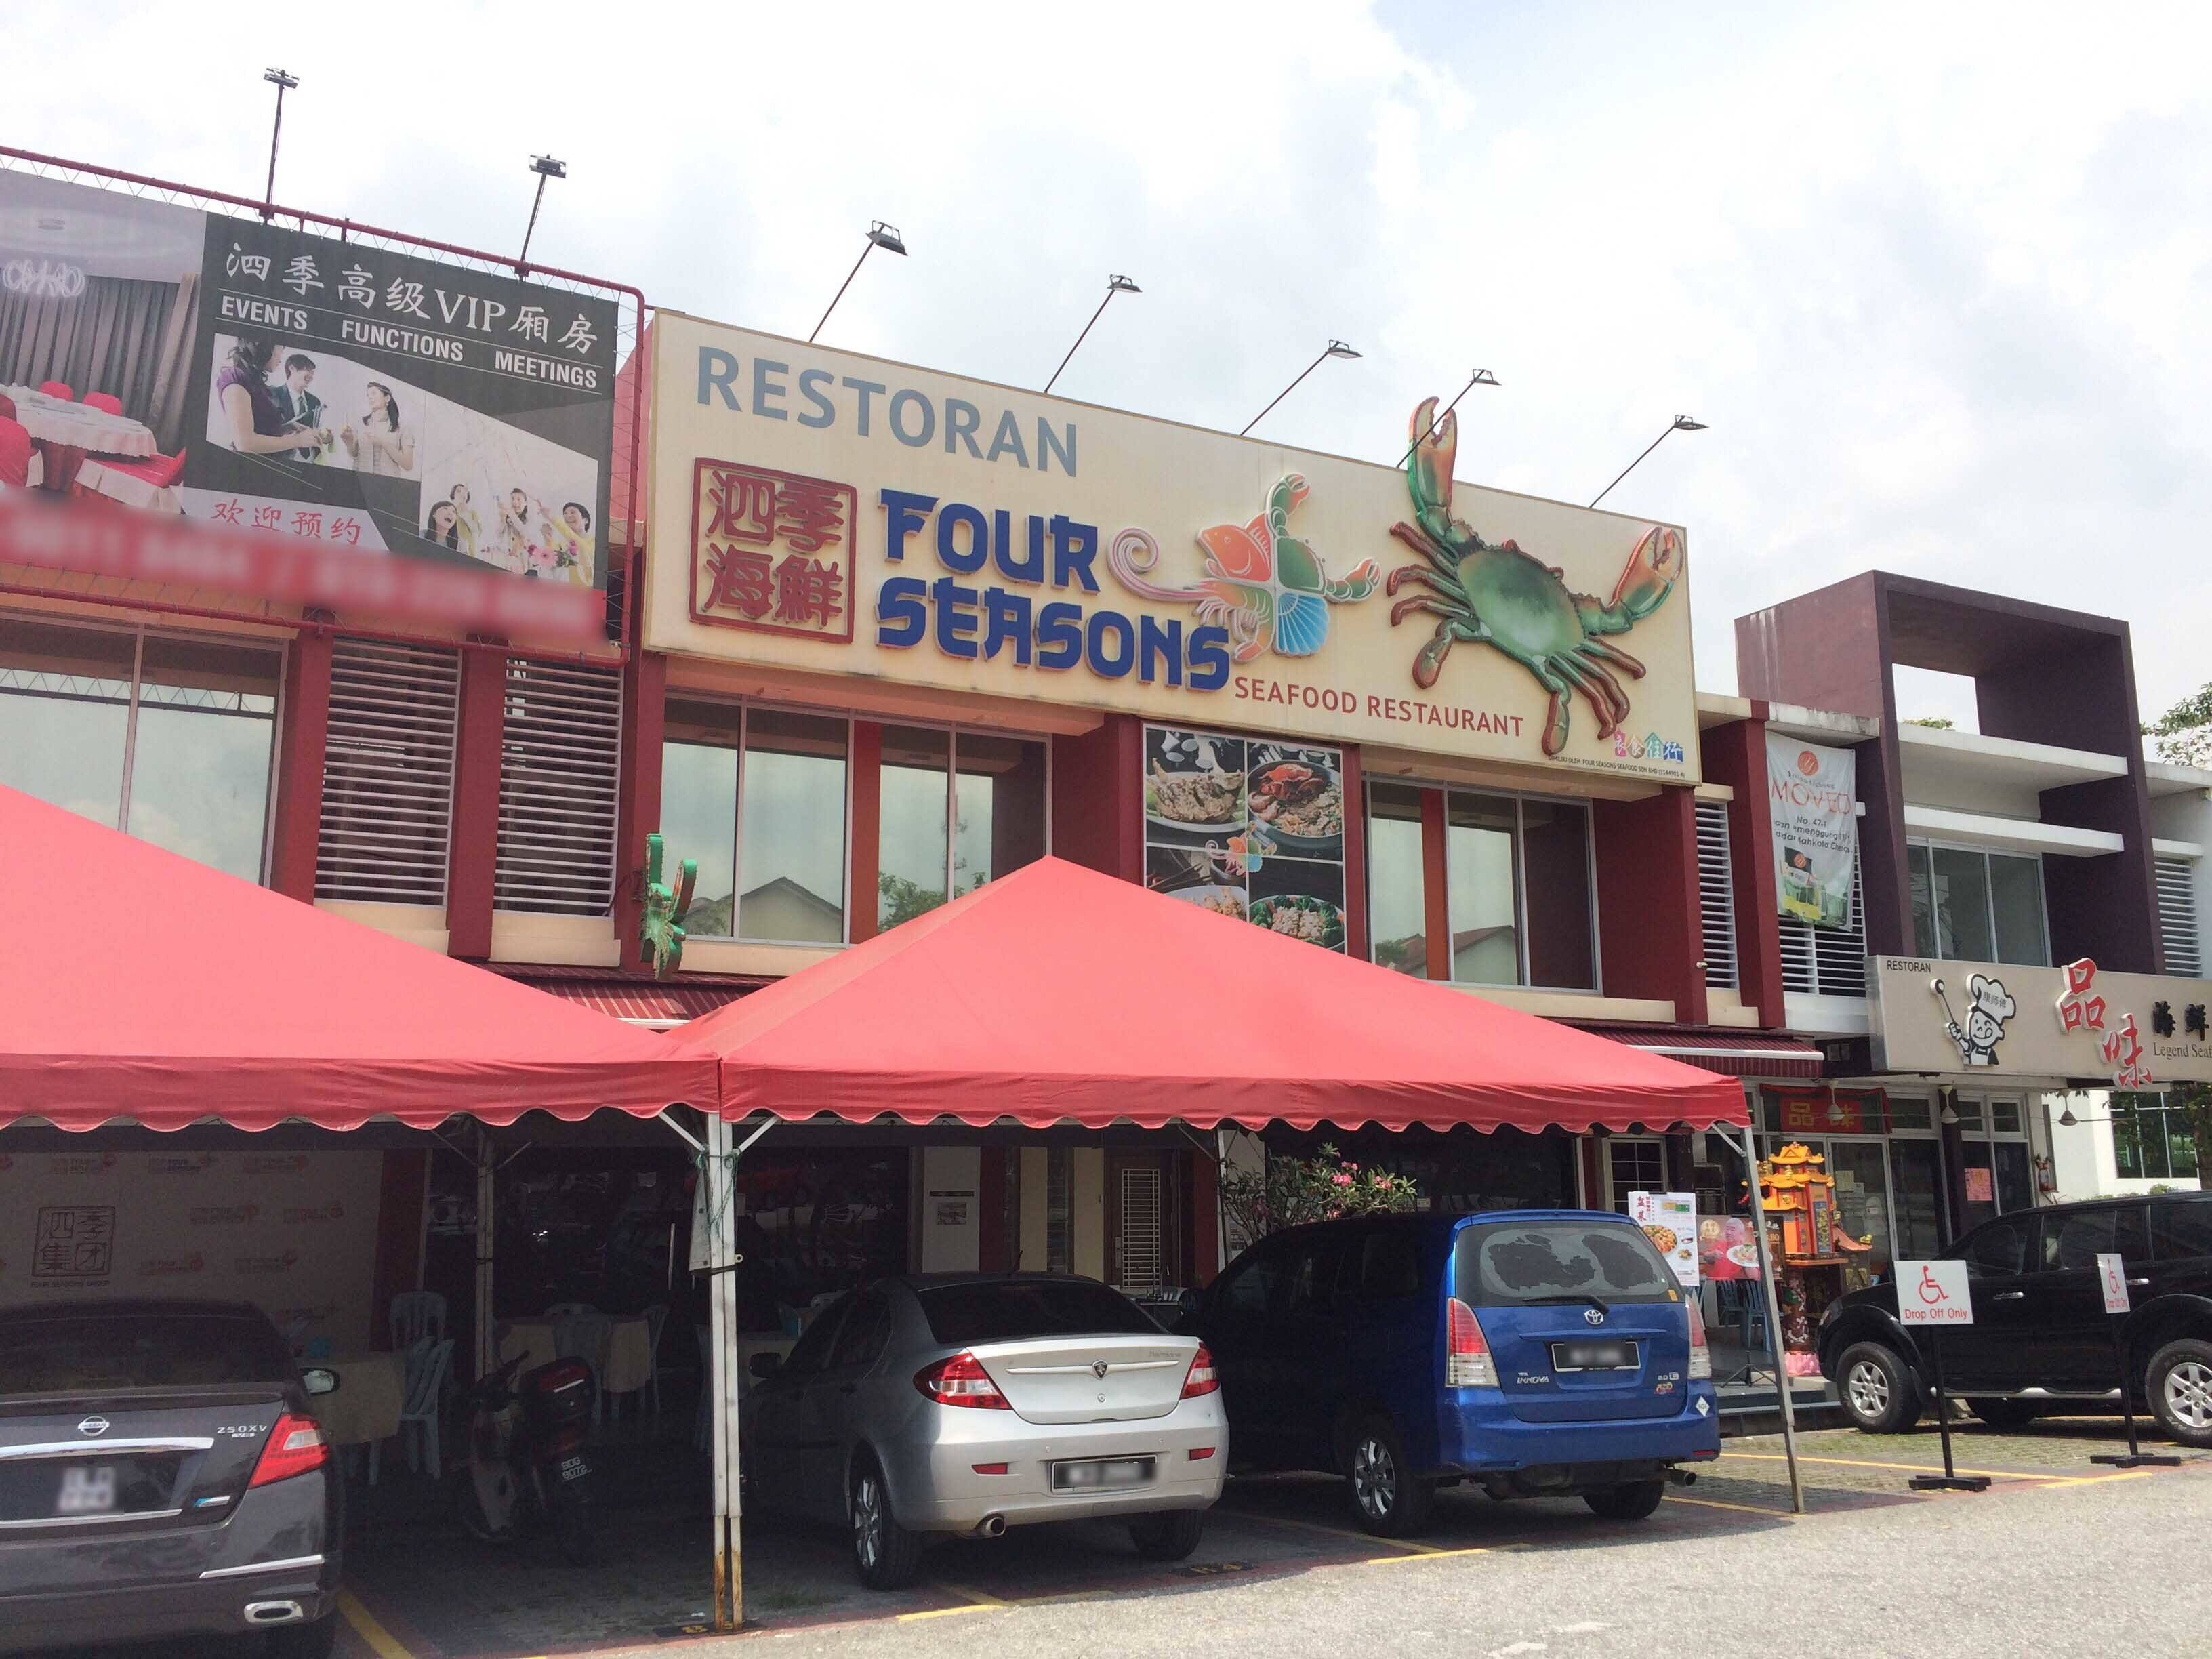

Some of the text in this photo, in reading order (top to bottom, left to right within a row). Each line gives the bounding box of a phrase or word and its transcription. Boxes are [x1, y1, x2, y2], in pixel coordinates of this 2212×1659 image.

[221, 295, 597, 389] EVENTS FUNCTIONS MEETINGS
[697, 346, 1078, 478] RESTORAN
[211, 498, 361, 546] 欢迎预约
[878, 487, 1101, 594] FOUR
[875, 575, 1231, 693] SEASONS
[1234, 676, 1525, 737] SEAFOOD RESTAURANT
[1582, 758, 1595, 767] FOUR
[1595, 760, 1617, 770] SEASONS
[1617, 762, 1637, 772] SEAFOOD
[1772, 779, 1851, 815] MOVED
[1886, 960, 1931, 973] RESTORAN
[2153, 1042, 2189, 1060] Legend
[1905, 1307, 1968, 1322] Drop Off Only
[1517, 1376, 1550, 1384] INNOVA
[217, 1425, 268, 1434] 250XV
